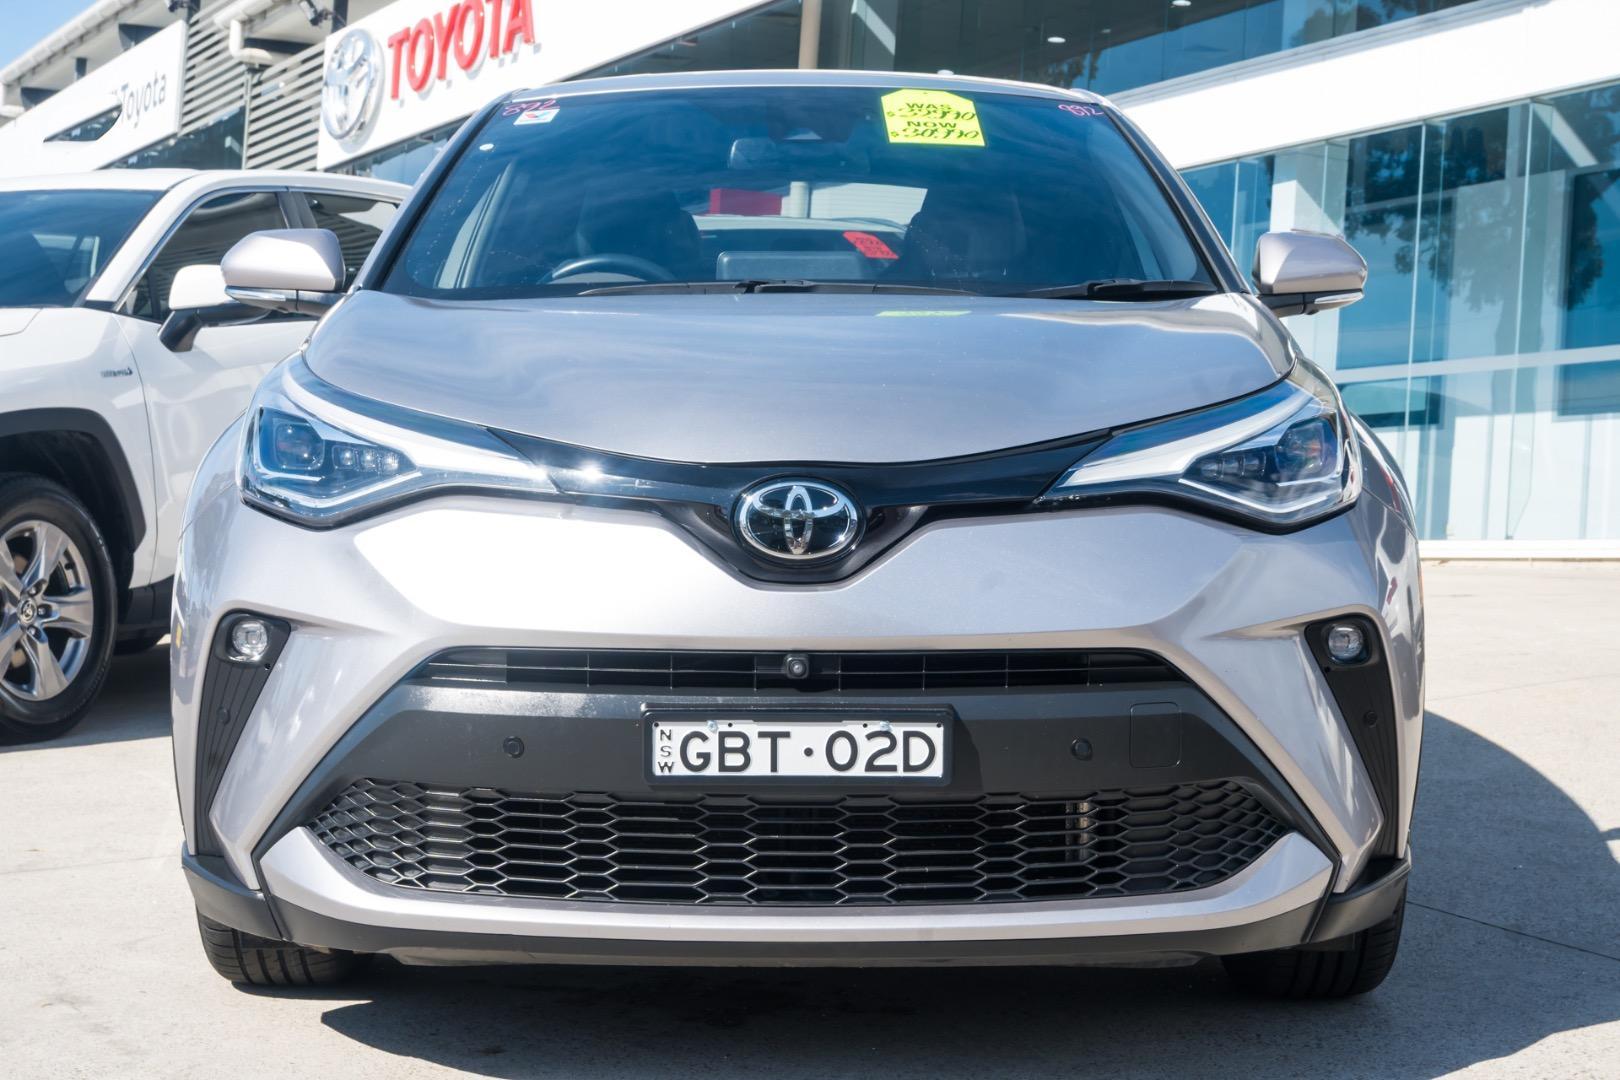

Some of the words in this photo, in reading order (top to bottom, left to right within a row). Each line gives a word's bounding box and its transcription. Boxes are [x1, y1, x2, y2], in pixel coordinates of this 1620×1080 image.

[387, 0, 535, 101] TOYOTA
[121, 72, 167, 128] Toyota
[906, 102, 953, 110] WAS
[906, 120, 958, 128] NOW
